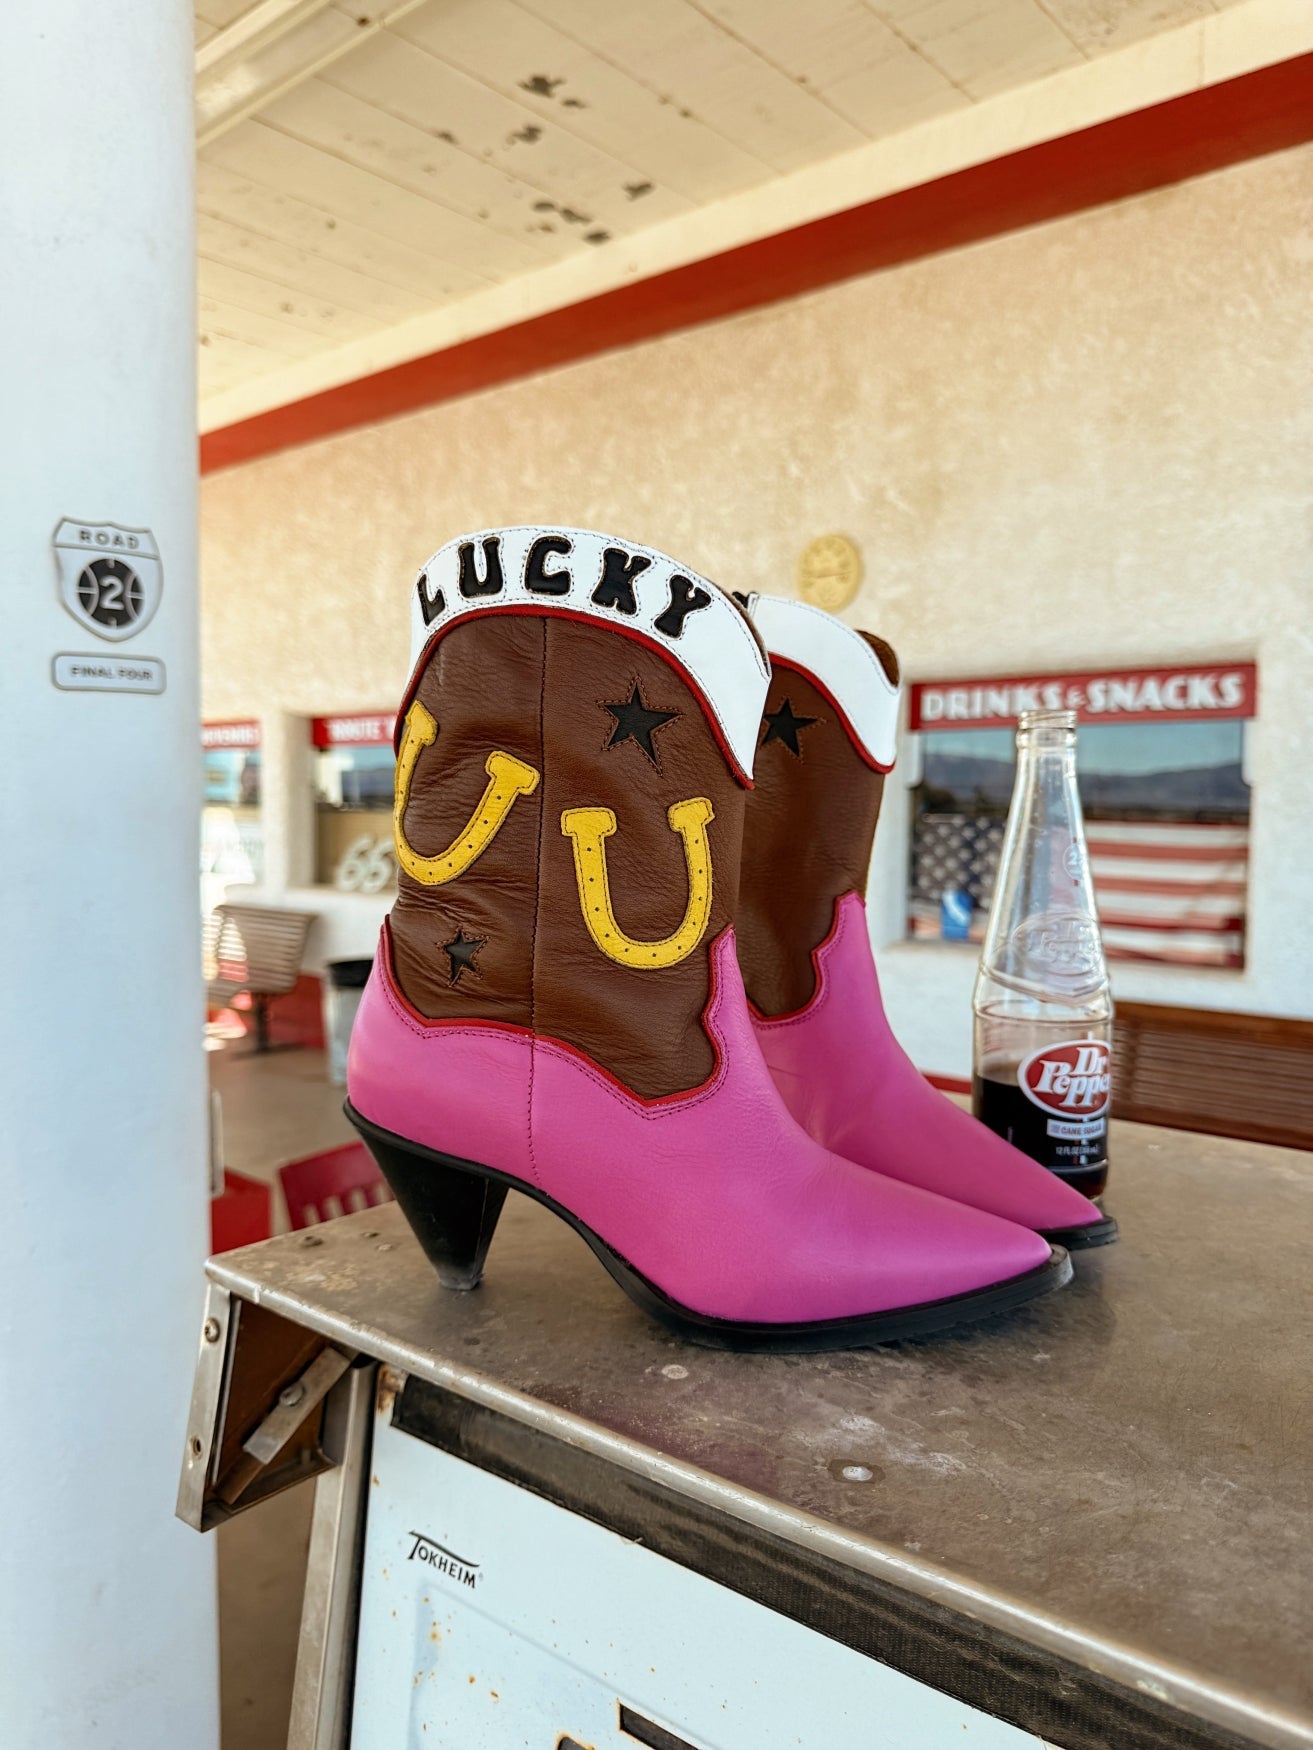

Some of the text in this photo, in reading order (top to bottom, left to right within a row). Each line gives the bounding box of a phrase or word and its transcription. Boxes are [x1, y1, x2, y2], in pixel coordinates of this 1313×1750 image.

[79, 530, 141, 550] ROAD
[100, 574, 125, 611] 2
[416, 534, 712, 639] LUCKY
[922, 673, 1243, 720] DRINKS & SNACKS
[1032, 1061, 1109, 1107] Peppe
[1069, 1046, 1108, 1077] Dr
[408, 1531, 479, 1588] TOKHEIM
